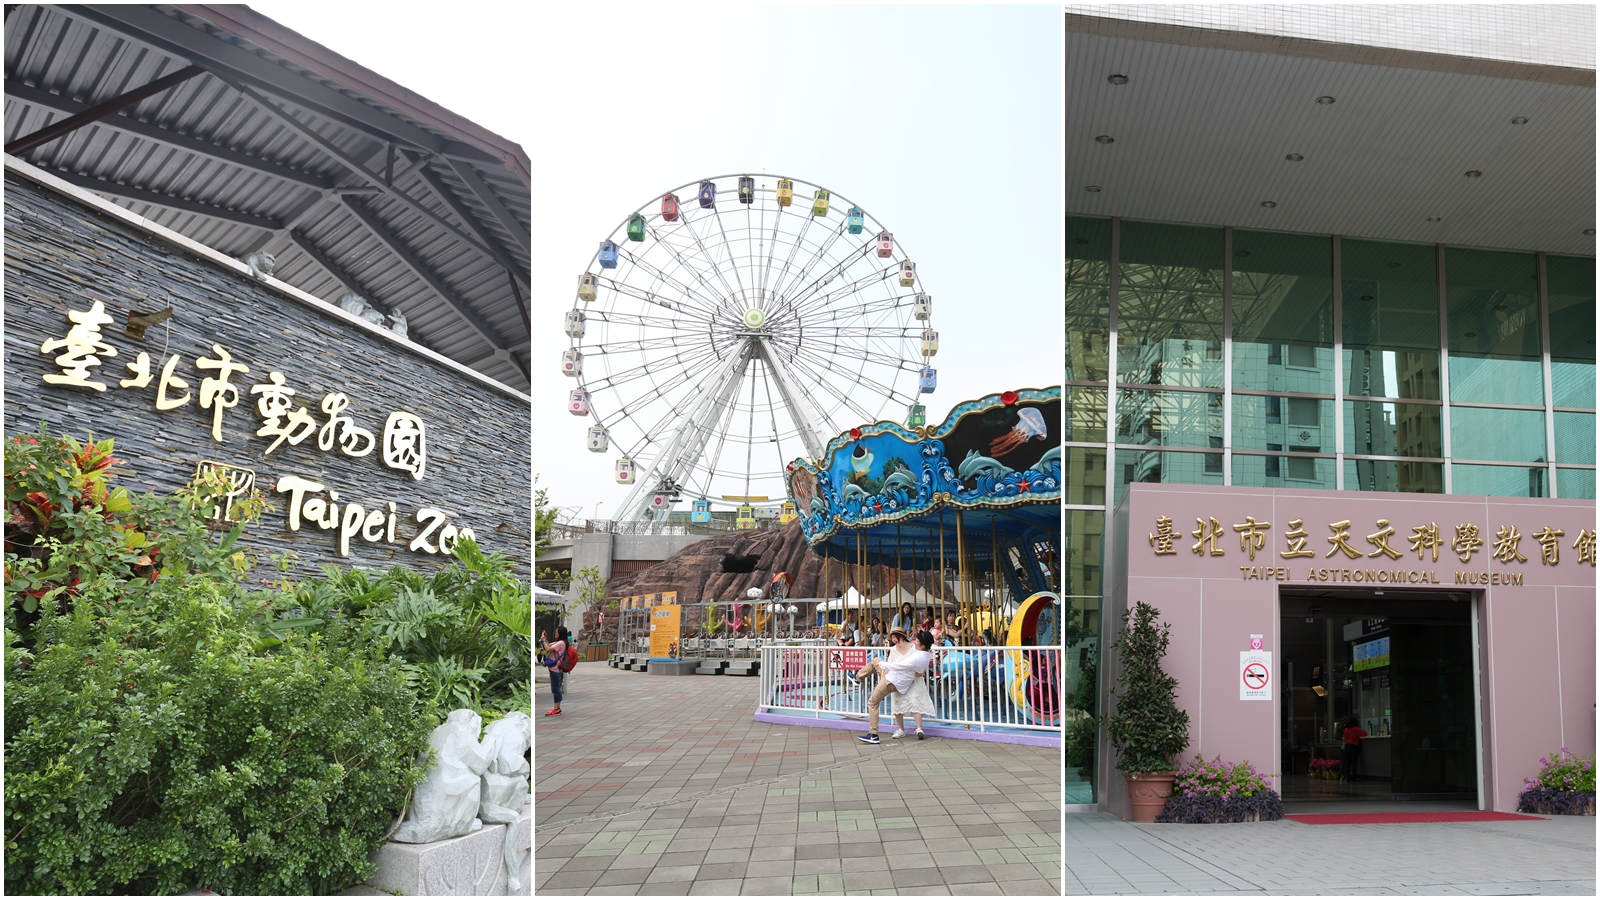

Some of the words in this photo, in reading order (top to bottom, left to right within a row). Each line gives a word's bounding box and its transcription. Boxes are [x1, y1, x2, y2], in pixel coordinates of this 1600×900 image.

[40, 300, 426, 480] 臺北市動物園
[277, 475, 397, 556] Taipei
[1148, 515, 1596, 567] 臺北市立天文科學教育館
[1240, 565, 1291, 581] TAIPEI
[1306, 568, 1440, 584] ASTRONOMICAL
[1454, 570, 1524, 586] MUSEUM
